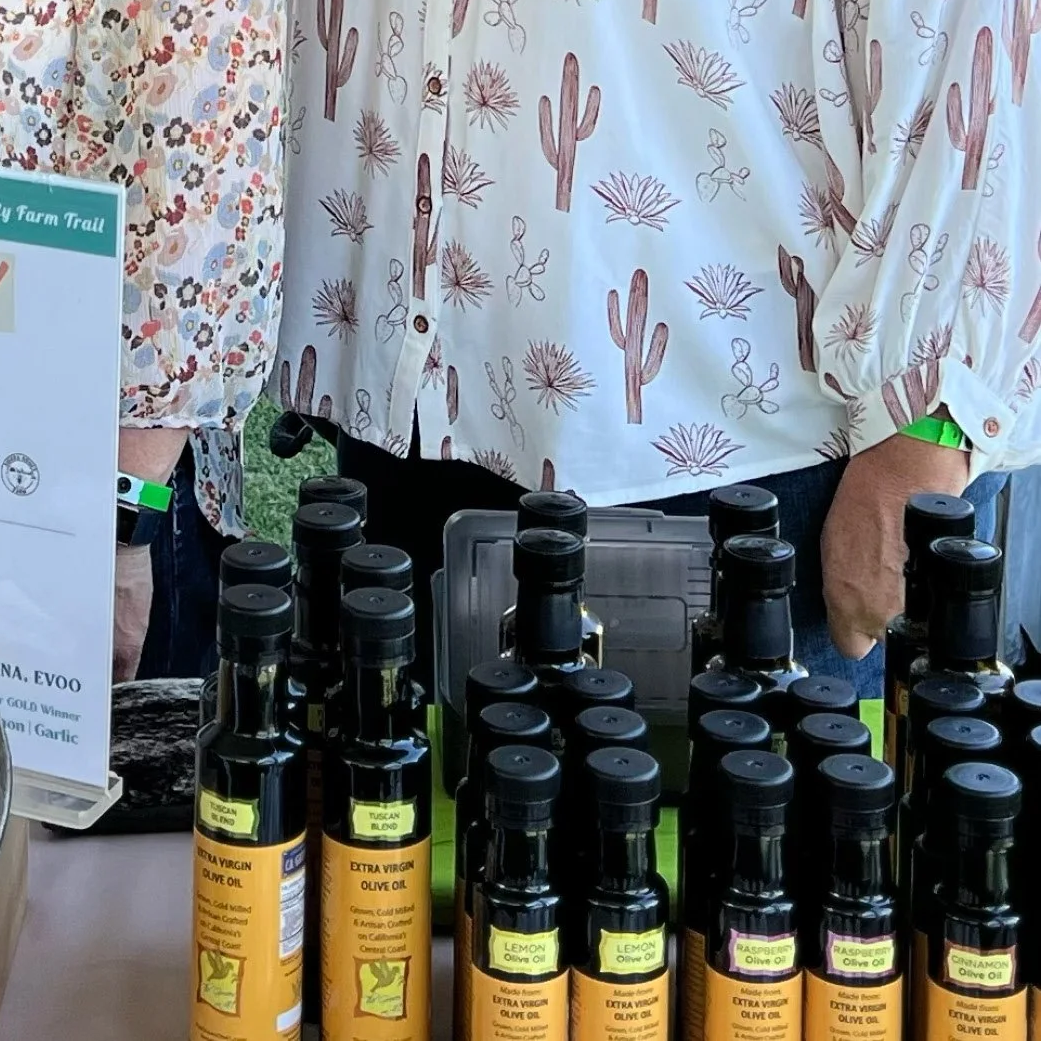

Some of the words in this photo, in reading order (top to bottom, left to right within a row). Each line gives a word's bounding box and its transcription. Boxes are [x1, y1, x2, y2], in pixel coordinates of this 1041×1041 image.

[16, 205, 58, 227] Farm
[63, 211, 105, 234] Trail
[33, 669, 82, 693] EVOO
[6, 696, 38, 713] GOLD
[40, 703, 82, 722] Winner
[34, 723, 79, 745] Garlic
[368, 811, 401, 821] TUSCAN
[370, 821, 399, 832] BLEND
[218, 856, 252, 872] VIRGIN
[350, 861, 381, 873] EXTRA
[382, 859, 415, 873] VIRGIN
[226, 876, 243, 889] OIL
[360, 880, 391, 892] OLIVE
[391, 880, 408, 891] OIL
[504, 942, 546, 953] LEMON
[616, 942, 656, 954] LEMON
[737, 943, 793, 956] RASPBERRY
[833, 945, 892, 957] RASPBERRY
[503, 953, 529, 963] Olive
[532, 953, 546, 963] Oil
[616, 954, 642, 964] Olive
[643, 952, 656, 962] Oil
[744, 955, 771, 965] Olive
[774, 955, 787, 965] Oil
[842, 957, 869, 968] Olive
[871, 957, 885, 966] Oil
[951, 954, 1009, 969] CINNAMON
[958, 967, 985, 980] Olive
[988, 971, 1002, 980] Oil
[492, 995, 519, 1008] EXTRA
[732, 996, 760, 1008] EXTRA
[829, 1000, 858, 1012] EXTRA
[499, 1010, 525, 1020] OLIVE
[526, 1011, 540, 1020] OIL
[613, 1011, 638, 1021] OLIVE
[740, 1010, 766, 1020] OLIVE
[767, 1011, 782, 1020] OIL
[837, 1014, 863, 1024] OLIVE
[865, 1015, 880, 1024] OIL
[948, 1009, 976, 1023] EXTRA
[956, 1023, 982, 1036] OLIVE
[984, 1027, 999, 1036] OIL
